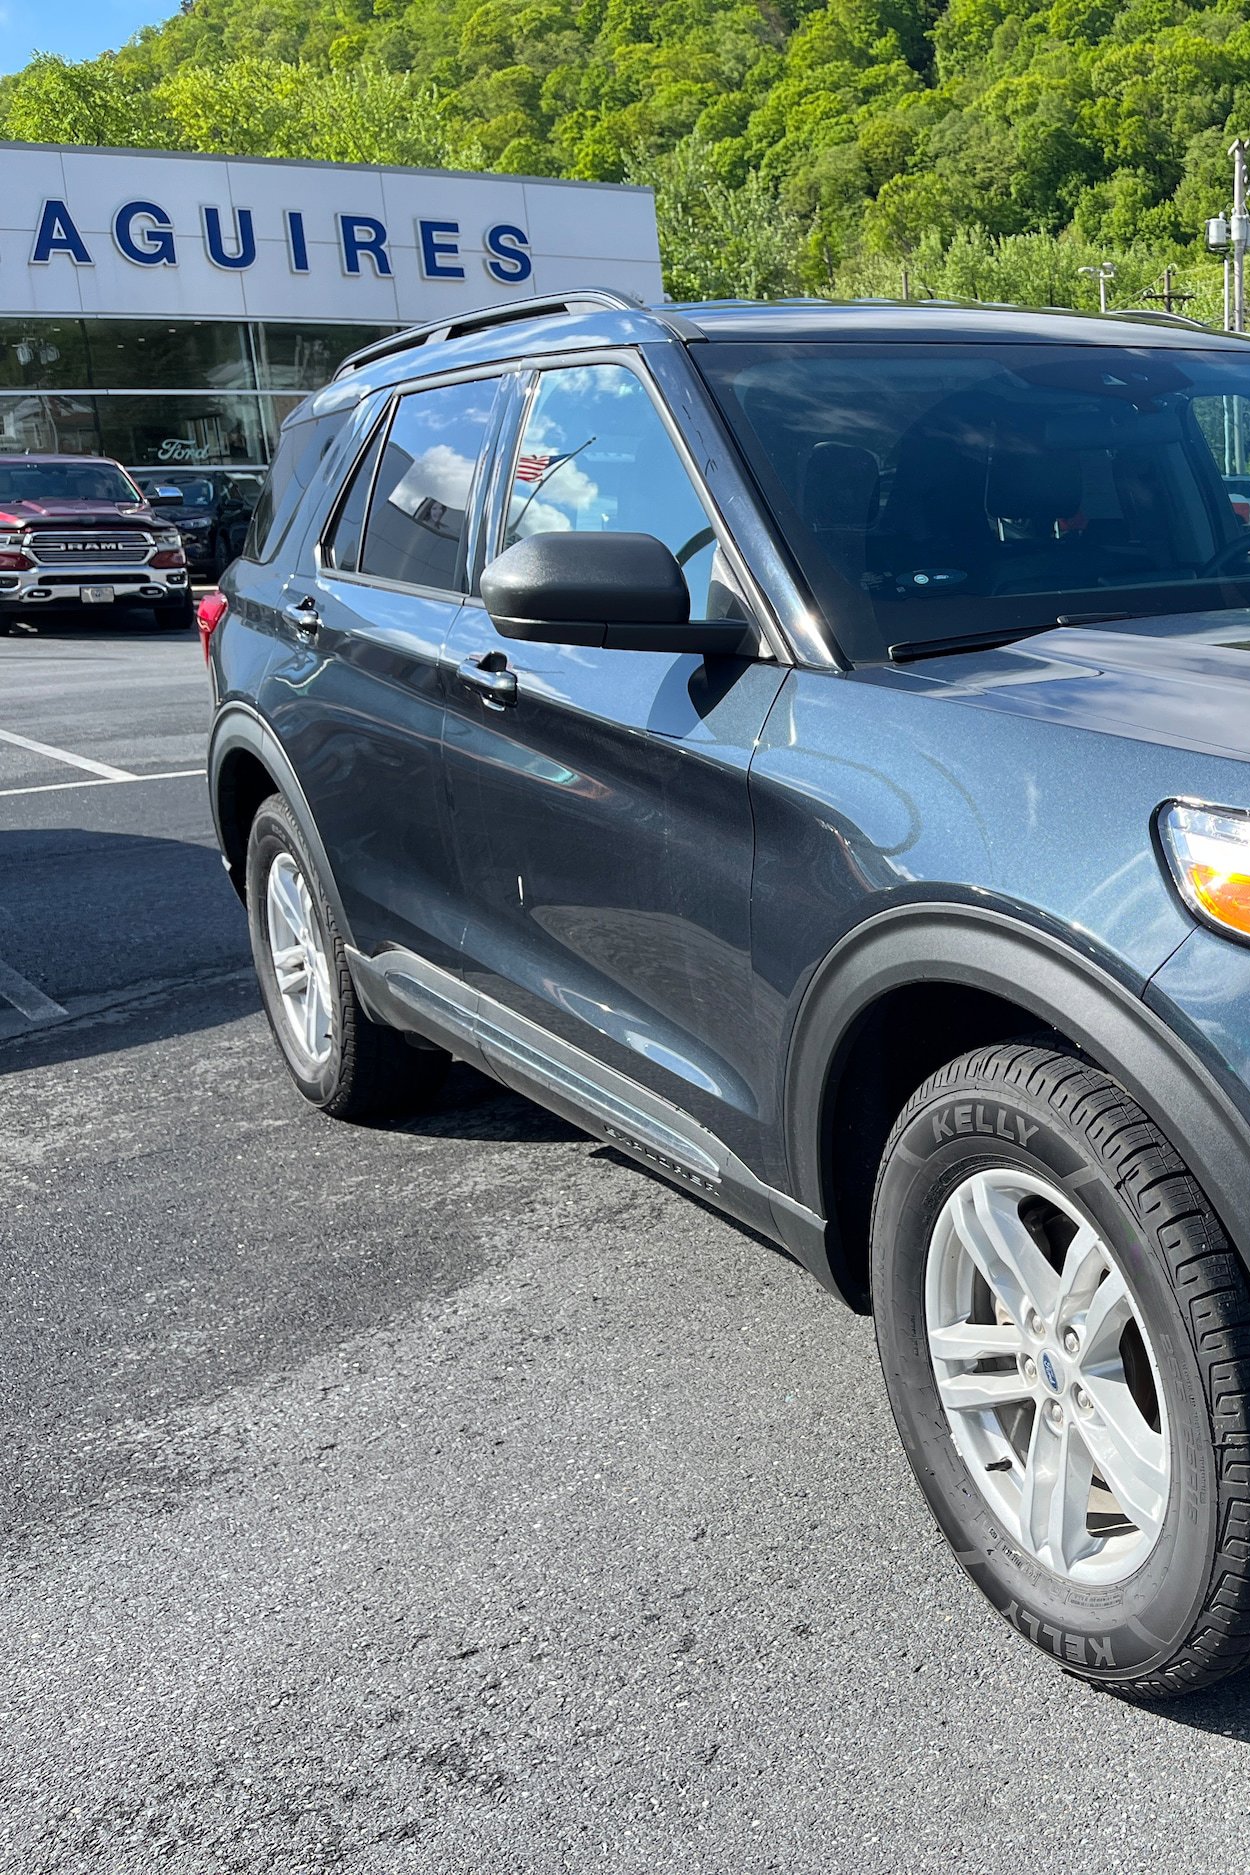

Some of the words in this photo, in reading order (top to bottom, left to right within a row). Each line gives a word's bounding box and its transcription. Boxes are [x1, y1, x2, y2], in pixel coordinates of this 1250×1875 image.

[31, 199, 533, 284] AGUIRES
[157, 438, 209, 460] Ford
[932, 1104, 1040, 1147] KELLY
[1000, 1599, 1117, 1667] KELLY
